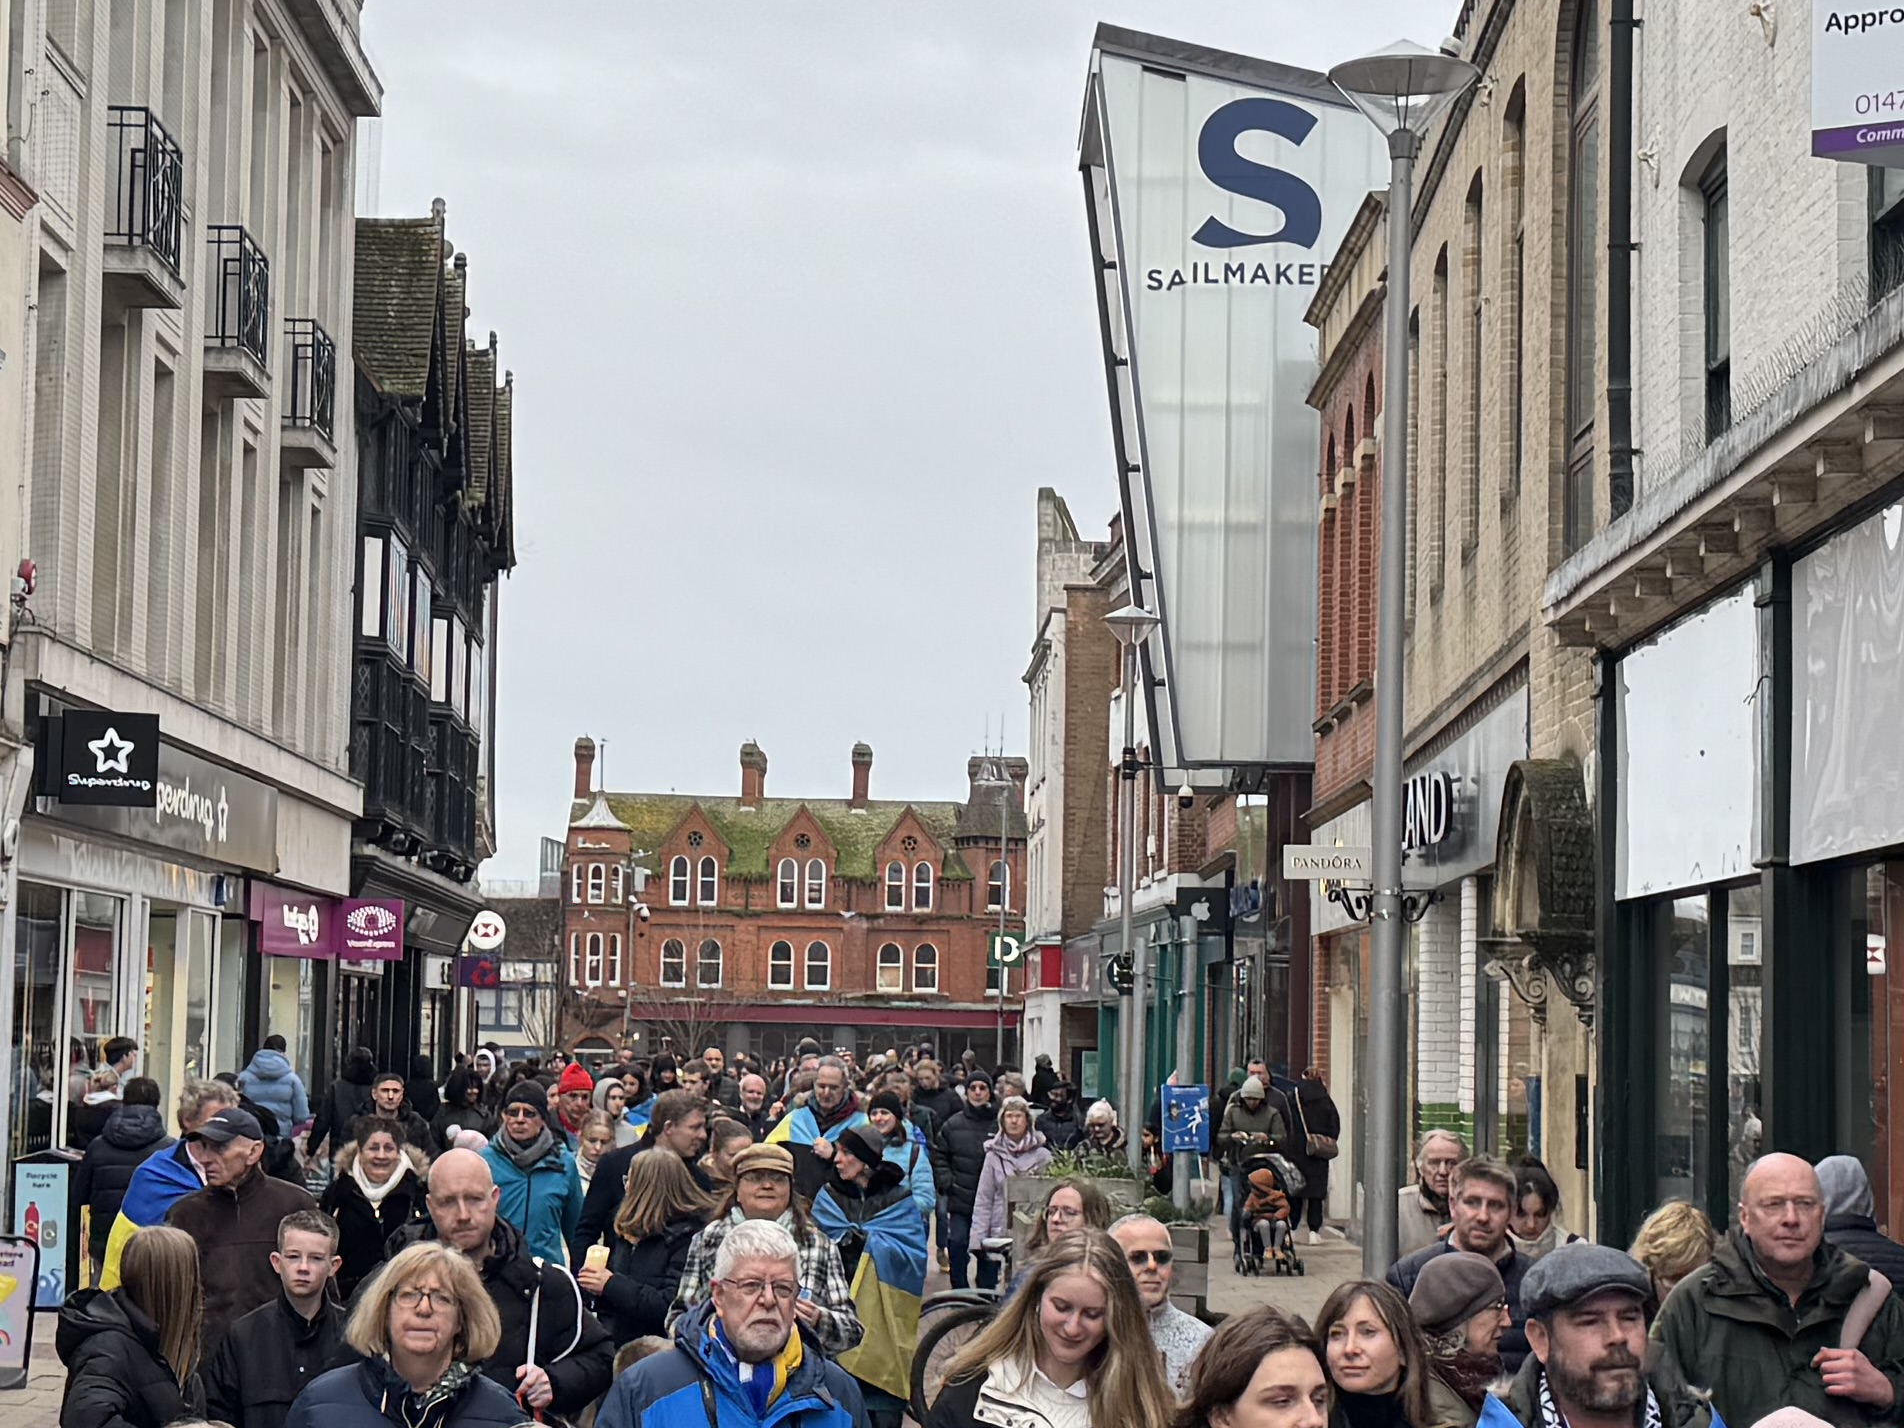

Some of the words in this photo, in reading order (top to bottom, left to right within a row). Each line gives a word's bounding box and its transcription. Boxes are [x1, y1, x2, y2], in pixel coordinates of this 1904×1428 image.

[1191, 97, 1323, 251] S
[67, 772, 153, 791] Superdrug
[156, 776, 215, 843] perdrug
[1402, 770, 1449, 850] AND
